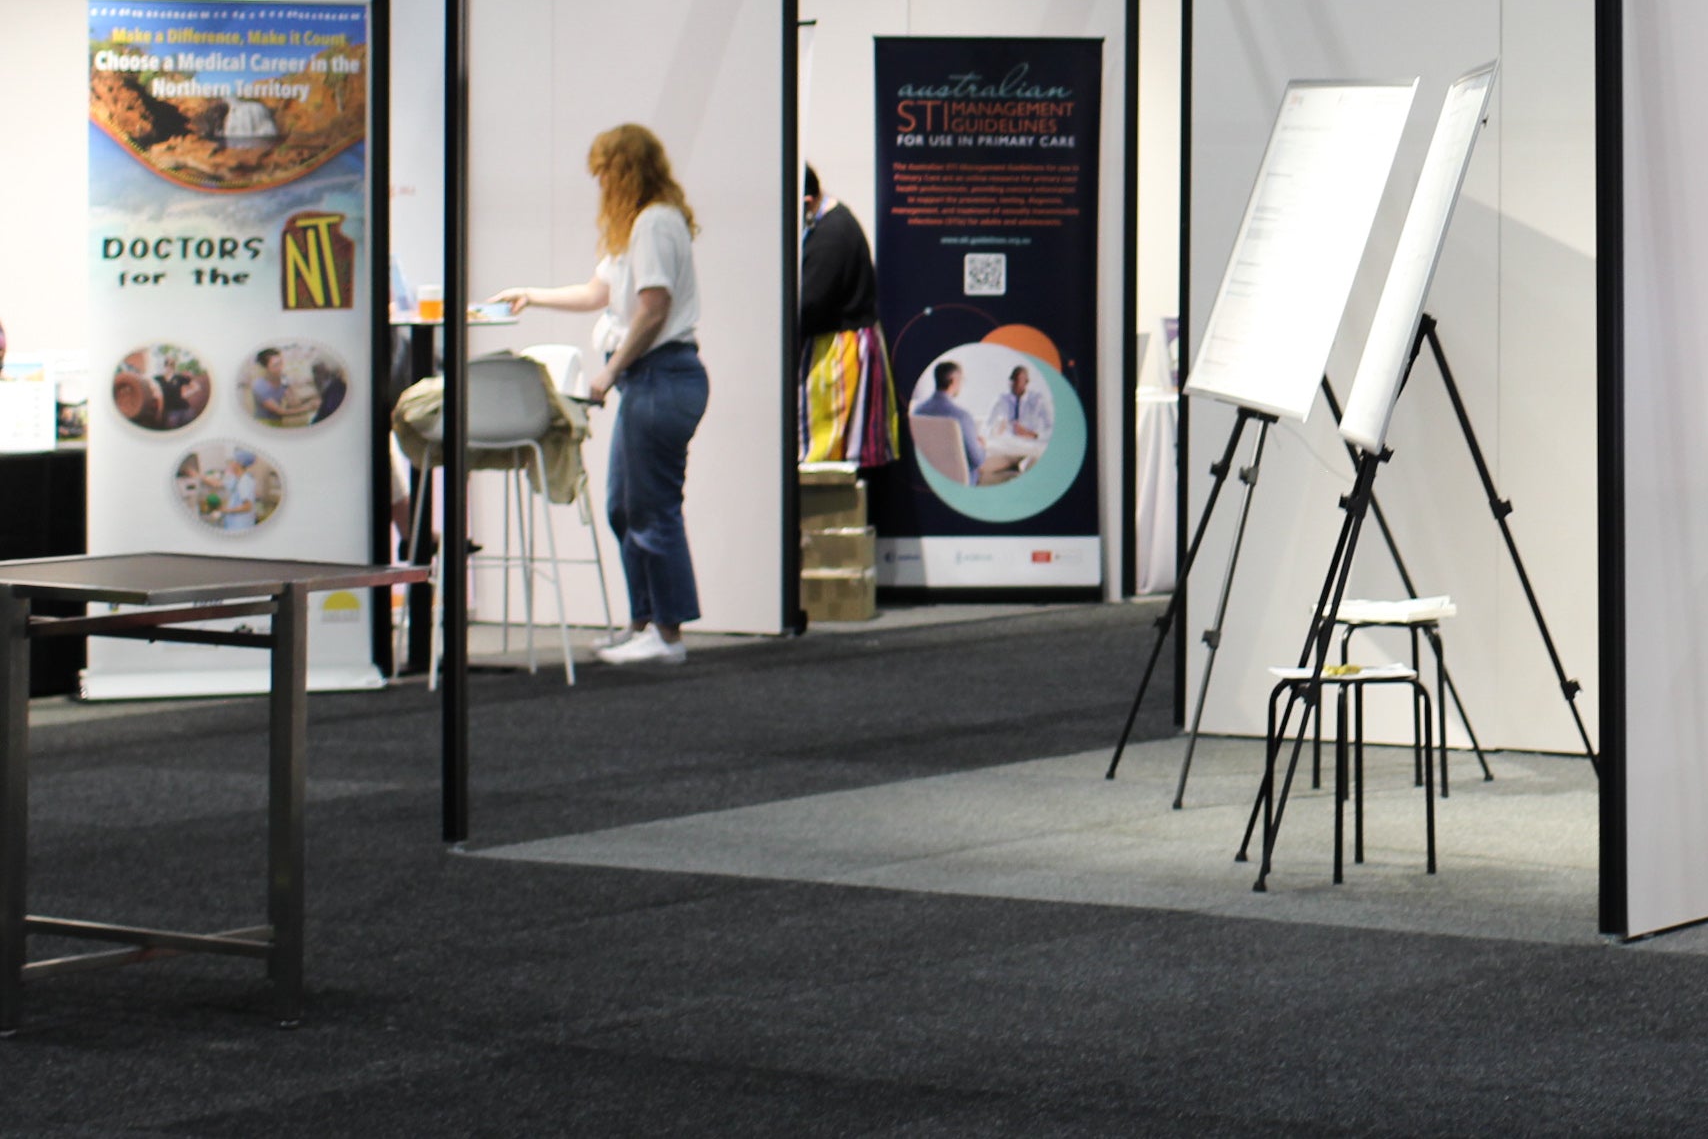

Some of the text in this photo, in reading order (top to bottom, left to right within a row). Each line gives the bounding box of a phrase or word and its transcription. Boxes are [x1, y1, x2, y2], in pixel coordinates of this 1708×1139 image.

[112, 27, 152, 45] Make
[155, 31, 164, 45] a
[167, 28, 244, 47] Difference,
[247, 29, 287, 46] Make
[289, 29, 302, 46] it
[94, 49, 360, 74] Choose a Medical Career in the
[151, 77, 312, 104] Northern Territory
[897, 62, 1073, 100] australian
[896, 99, 949, 134] STI
[951, 101, 1076, 118] MANAGEMENT
[951, 117, 1059, 135] GUIDELINES
[896, 134, 1077, 149] FOR USE IN PRIMARY CARE
[102, 236, 265, 261] DOCTORS
[283, 214, 343, 309] NT
[118, 267, 251, 288] for the
